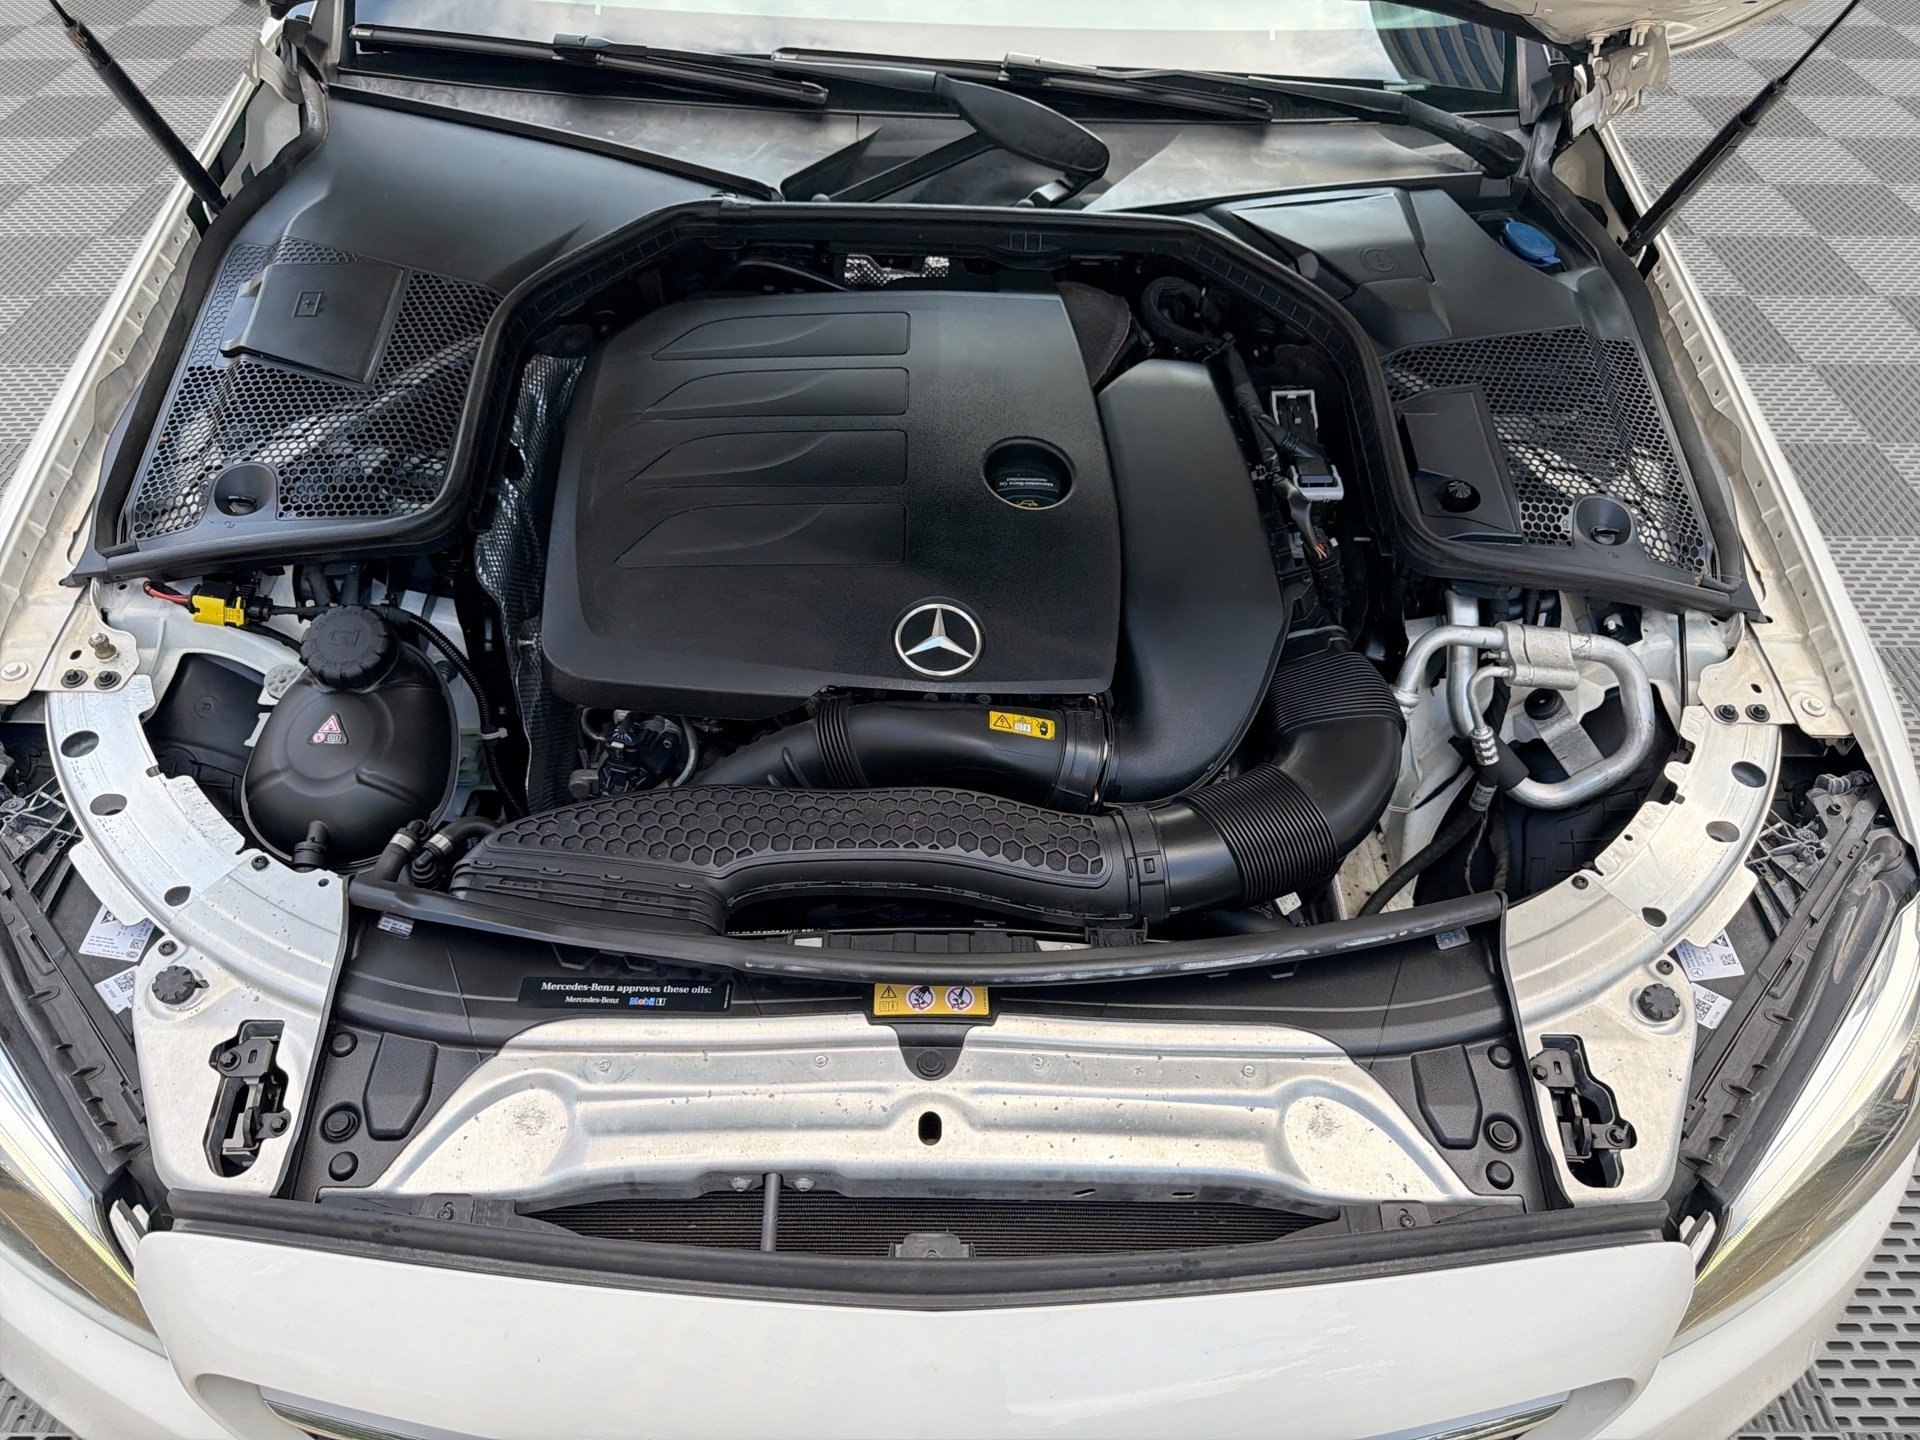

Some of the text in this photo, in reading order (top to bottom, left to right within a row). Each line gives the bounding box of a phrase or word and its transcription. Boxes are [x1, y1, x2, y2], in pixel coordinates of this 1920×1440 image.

[541, 981, 713, 994] Mercedes-Benz approves these oils:
[564, 995, 620, 1004] Mercedes-Benz
[629, 997, 656, 1006] Mobil
